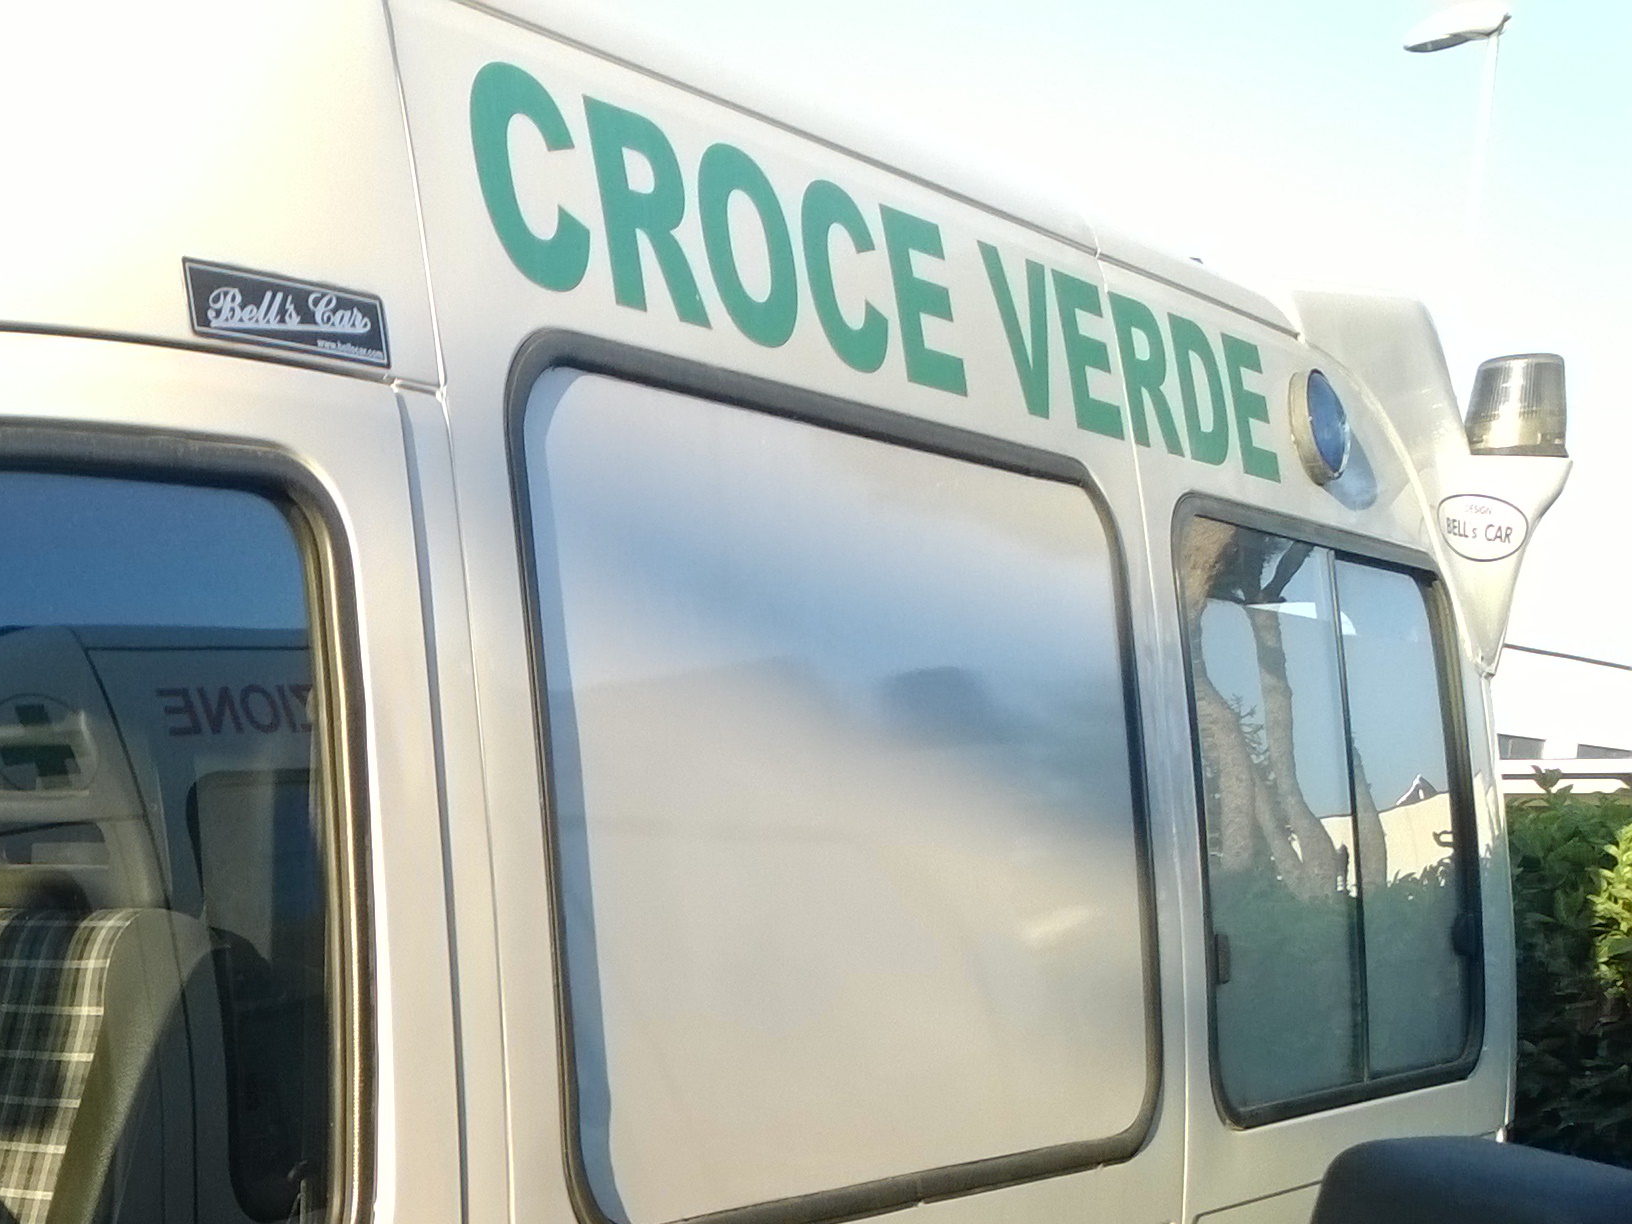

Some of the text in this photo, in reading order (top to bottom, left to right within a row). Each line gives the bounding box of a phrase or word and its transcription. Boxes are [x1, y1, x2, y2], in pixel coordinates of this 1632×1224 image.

[470, 60, 1282, 484] CROCE VERDE
[206, 287, 372, 333] Bell's Car
[1484, 523, 1514, 544] CAR
